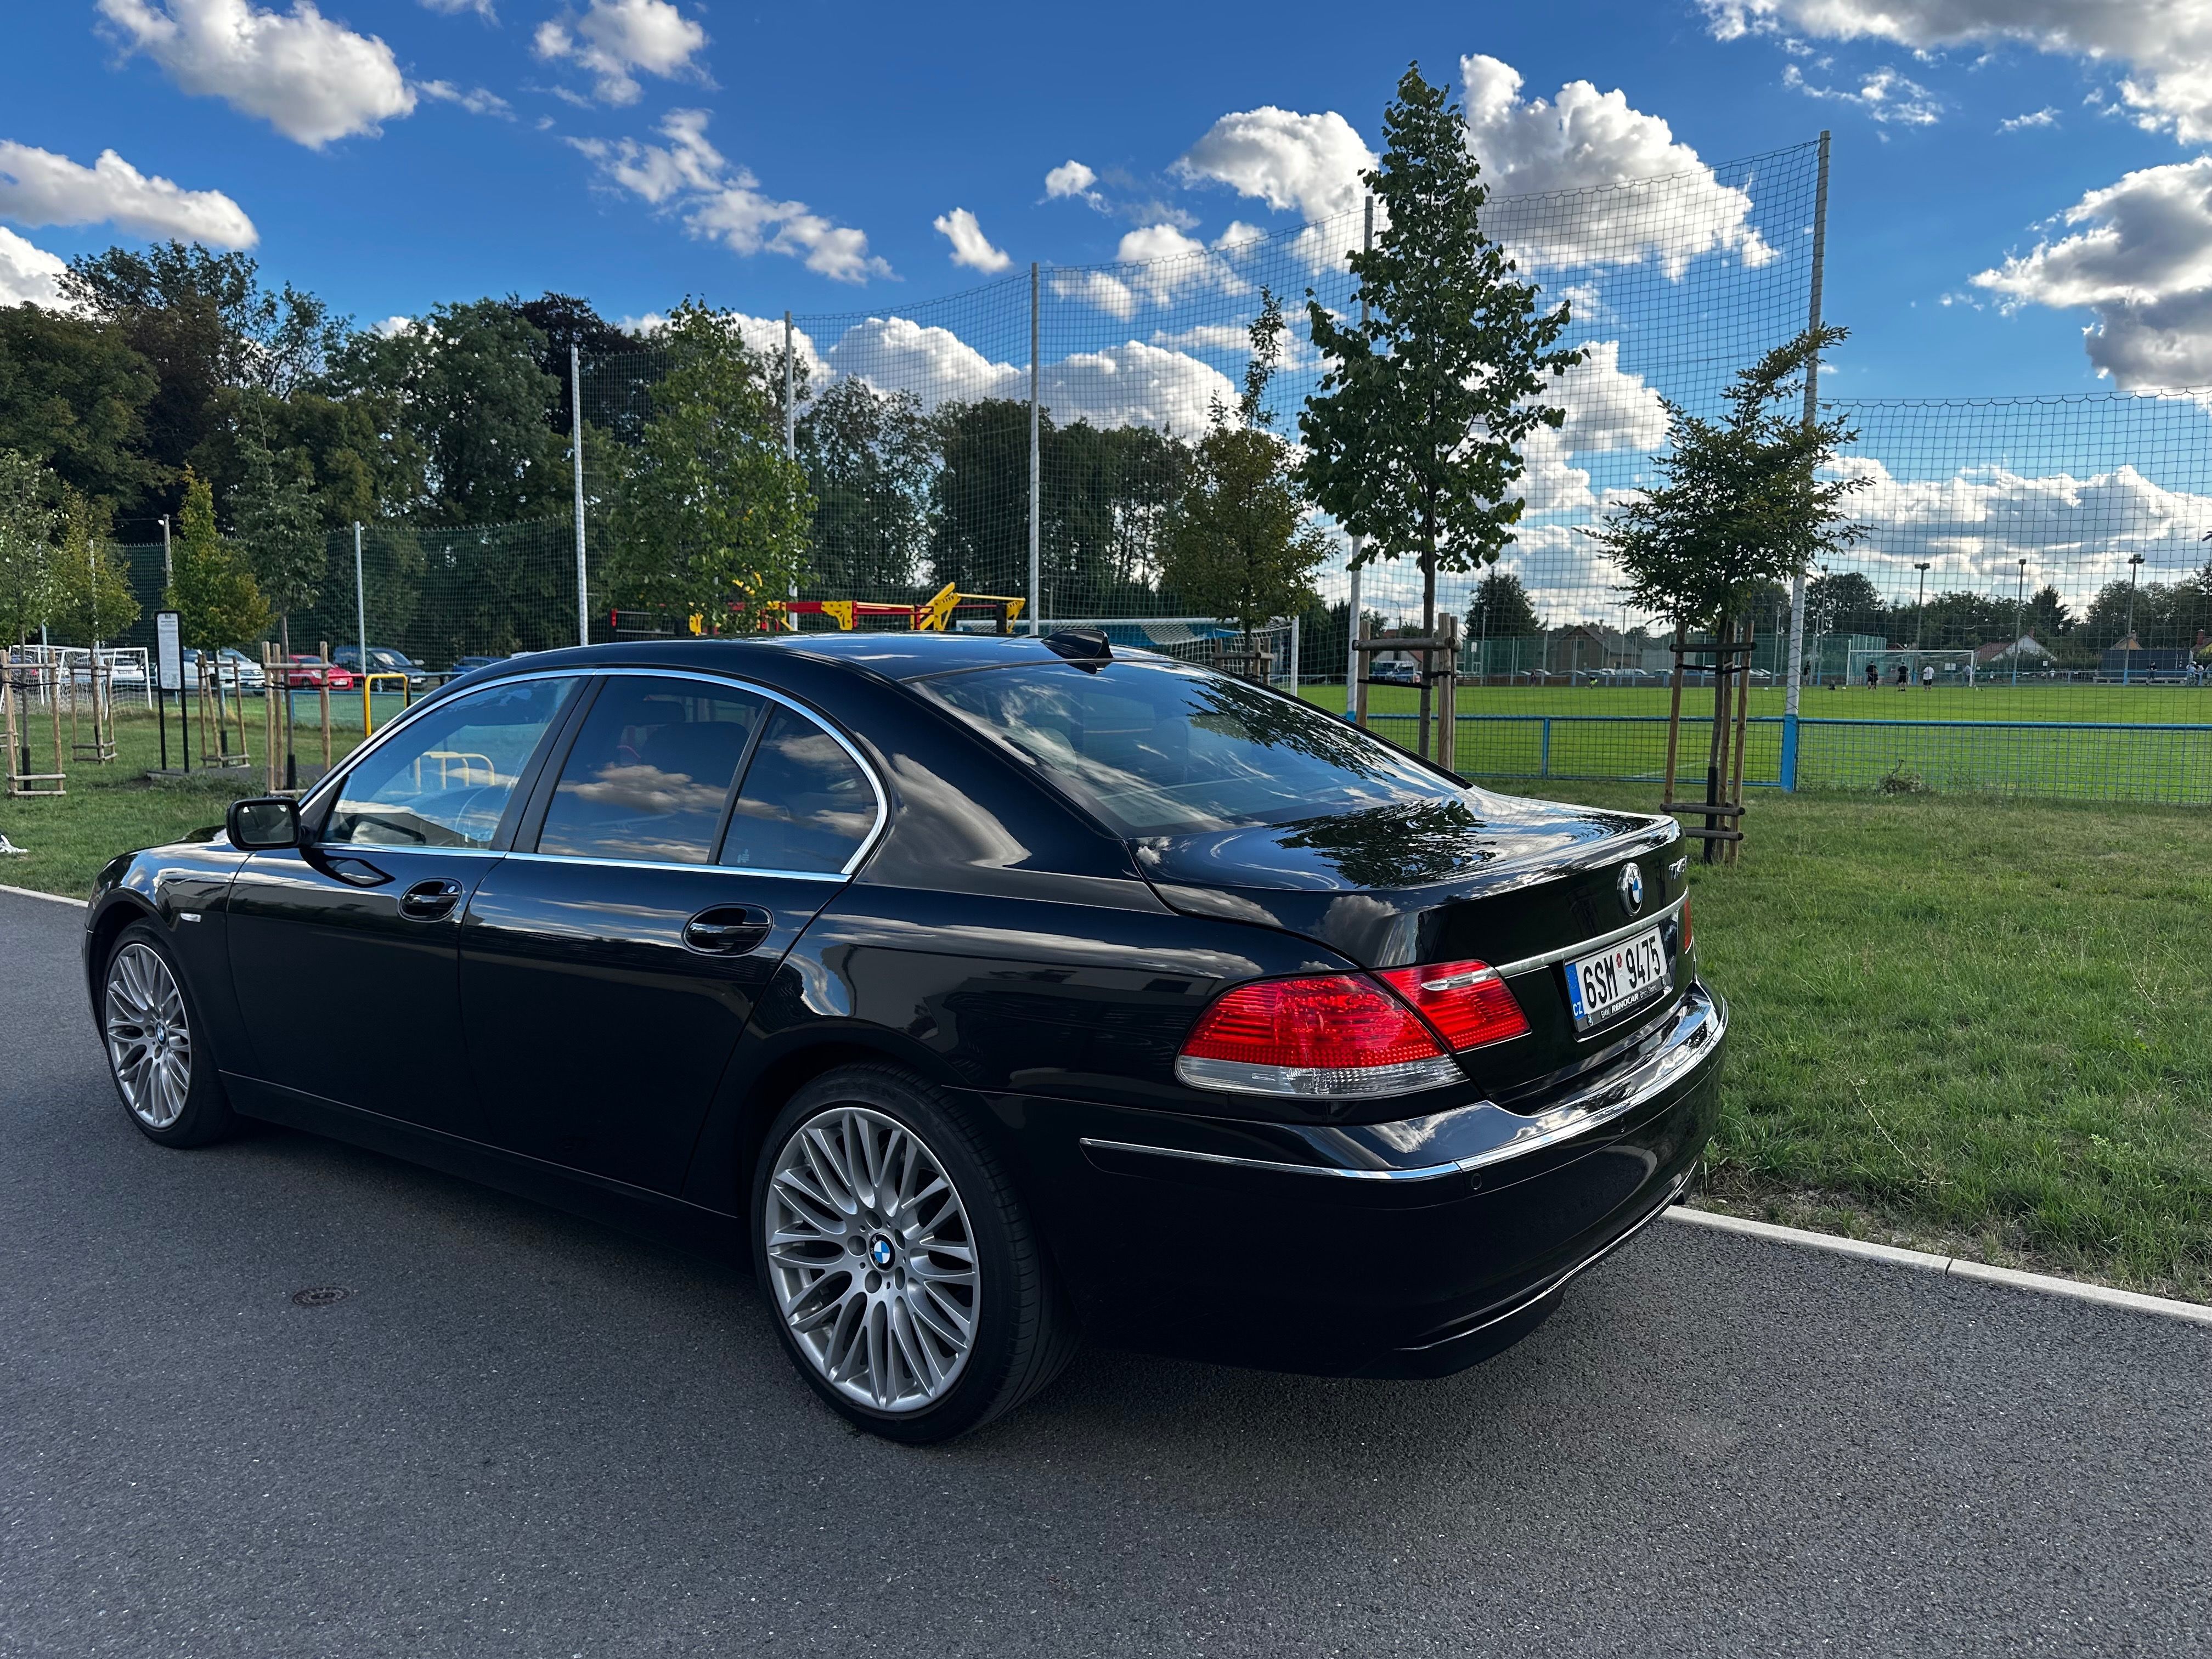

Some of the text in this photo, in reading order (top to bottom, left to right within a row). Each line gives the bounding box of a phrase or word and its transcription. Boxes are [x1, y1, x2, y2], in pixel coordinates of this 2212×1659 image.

[1583, 935, 1661, 1009] 6SM 9475
[1572, 1002, 1583, 1017] CZ
[1611, 993, 1639, 1014] RENOCAR
[820, 1081, 899, 1101] NEXEN
